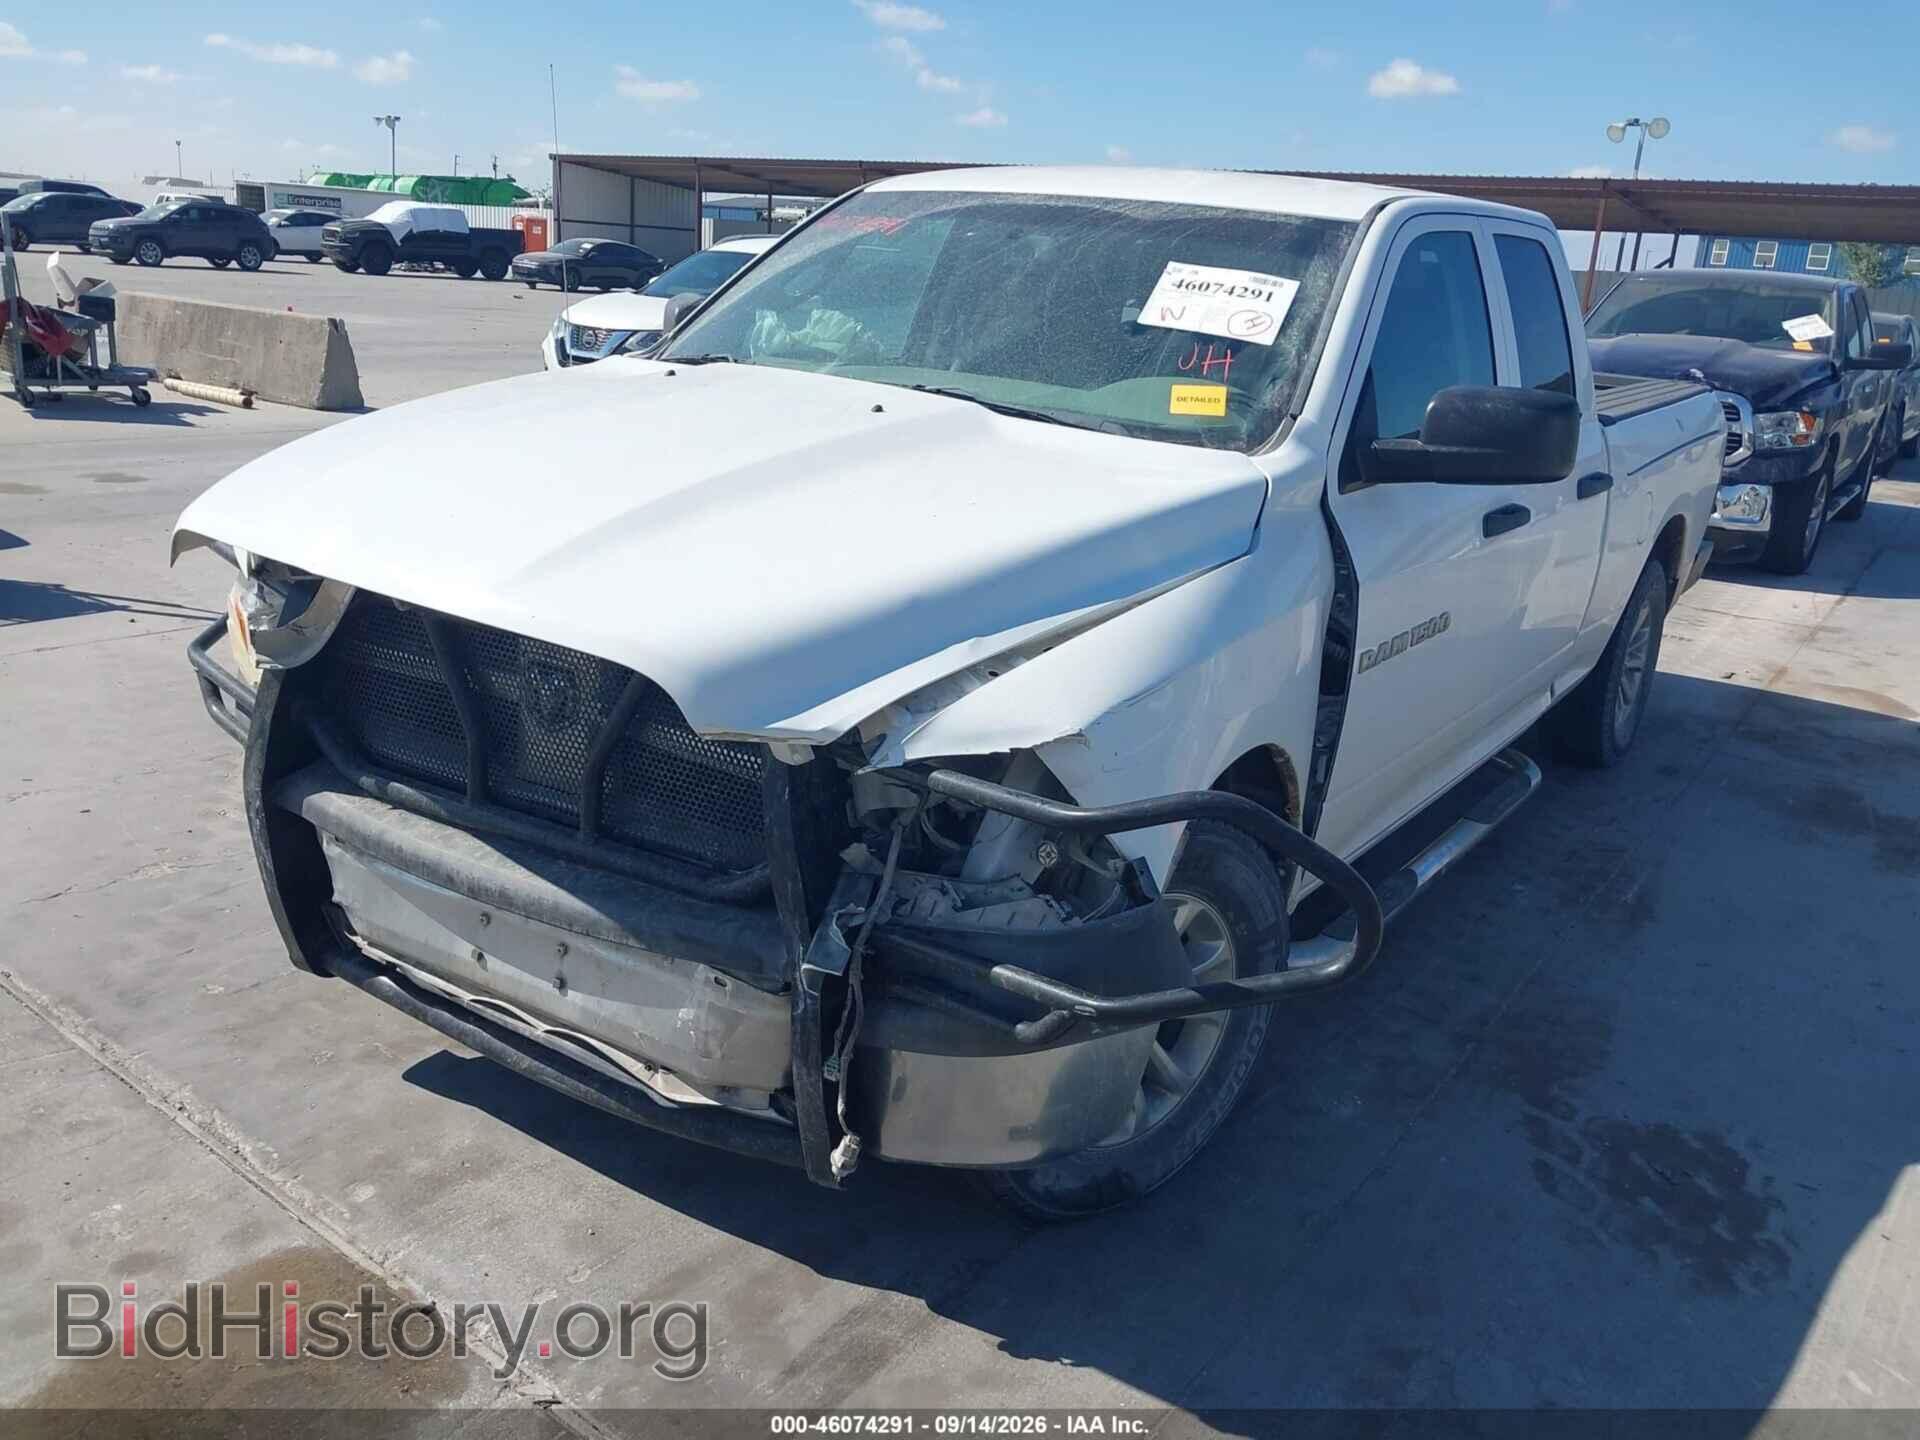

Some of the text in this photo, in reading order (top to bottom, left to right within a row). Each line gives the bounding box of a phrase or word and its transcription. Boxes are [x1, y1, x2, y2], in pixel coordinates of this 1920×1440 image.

[288, 195, 342, 208] Enterprise
[1171, 277, 1274, 303] 46074291
[1176, 395, 1221, 405] DETAILED
[1358, 611, 1452, 674] RAM 1500
